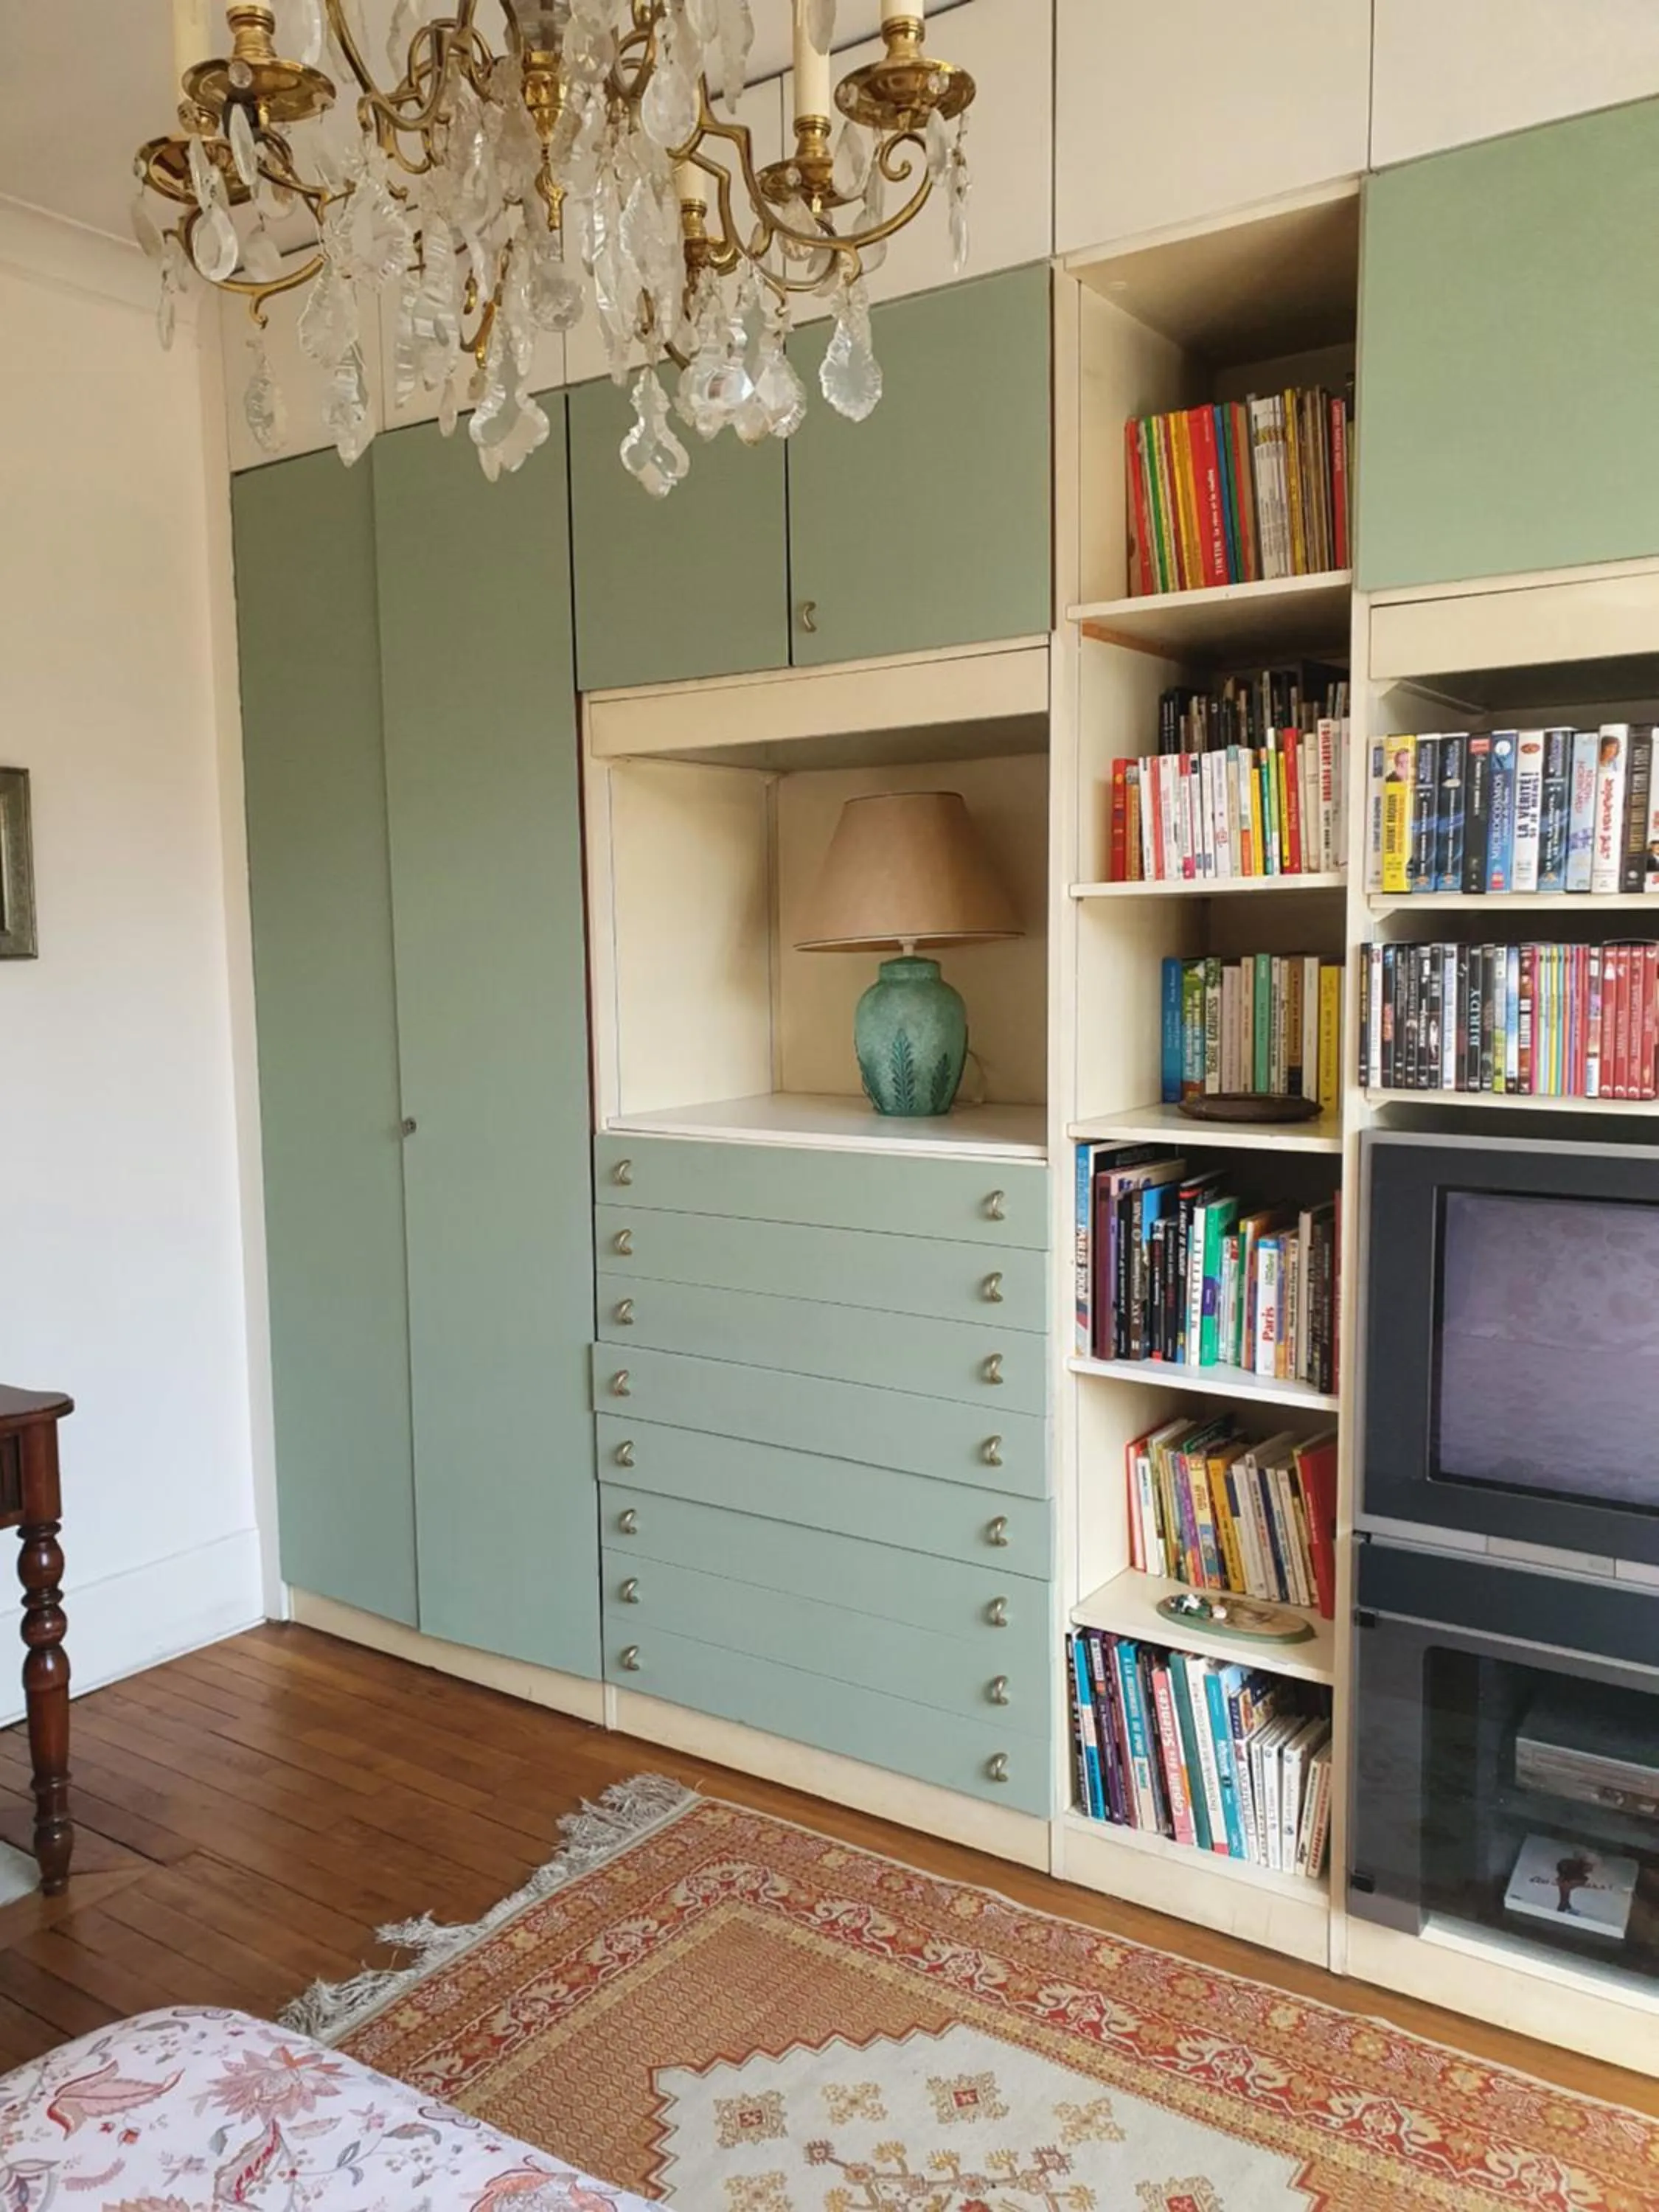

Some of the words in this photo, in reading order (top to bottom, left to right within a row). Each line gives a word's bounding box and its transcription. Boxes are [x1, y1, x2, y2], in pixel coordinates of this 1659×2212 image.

[1490, 773, 1504, 860] MICROCOSMOS
[1517, 824, 1528, 838] LA
[1470, 987, 1481, 1047] BIRDY
[1076, 1223, 1087, 1265] PARIS
[1191, 1237, 1202, 1329] MARSEILLE
[1262, 1305, 1275, 1342] Paris
[1156, 1687, 1175, 1747] Sciences
[1166, 1750, 1178, 1770] des
[1169, 1772, 1186, 1818] Copain
